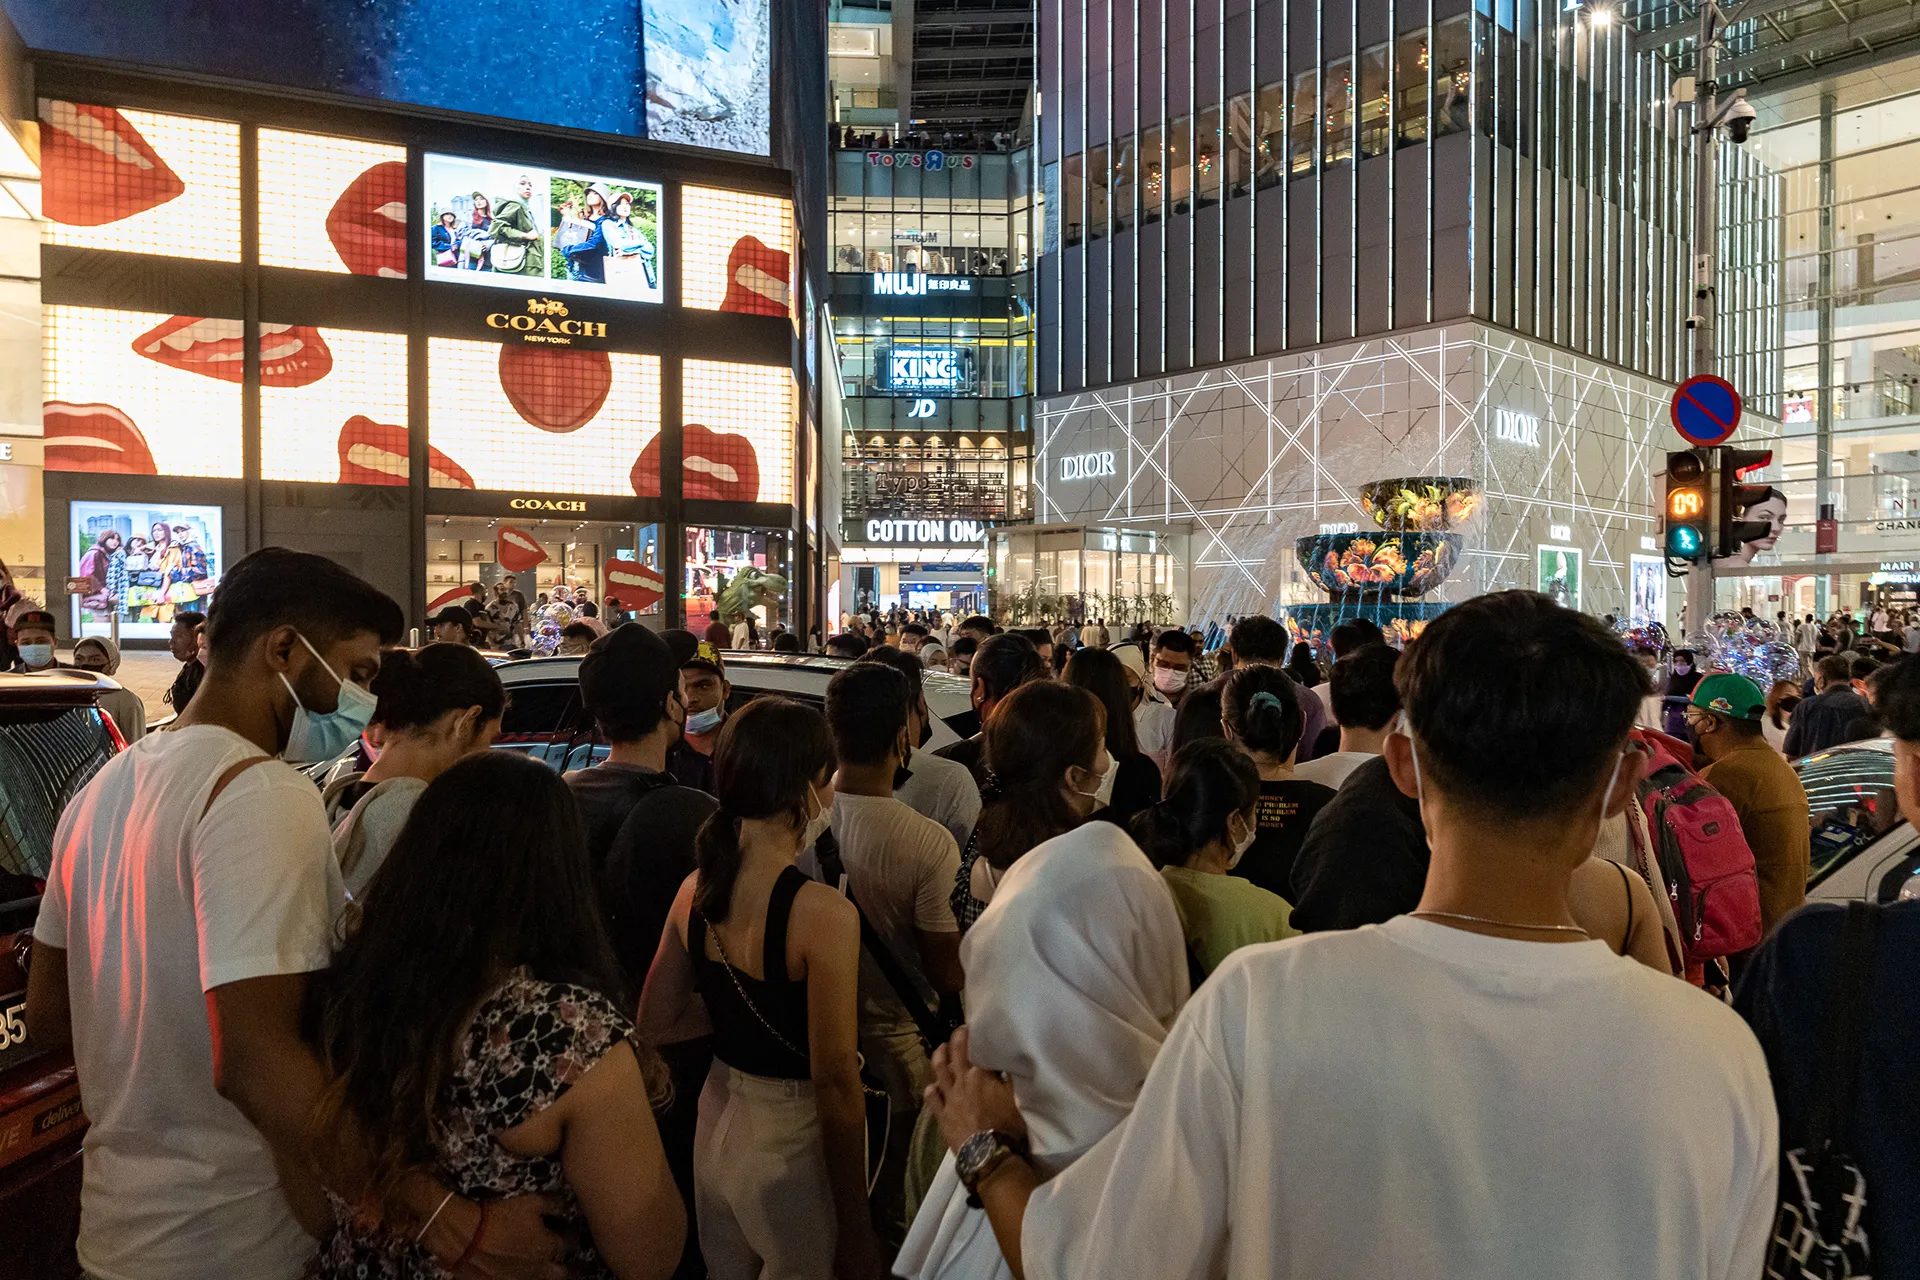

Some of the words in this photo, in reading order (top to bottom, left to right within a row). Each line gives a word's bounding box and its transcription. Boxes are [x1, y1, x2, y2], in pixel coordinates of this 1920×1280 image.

[874, 273, 927, 295] MUJI
[486, 313, 607, 338] COACH
[524, 335, 546, 344] NEW
[547, 336, 571, 345] YORK
[890, 358, 957, 378] KING
[908, 399, 936, 418] JD
[1496, 411, 1541, 446] DIOR
[1060, 451, 1117, 480] DIOR
[876, 472, 930, 495] Typo
[509, 498, 587, 512] COACH
[1674, 494, 1697, 514] 09
[867, 520, 944, 542] COTTON
[949, 521, 977, 542] ON
